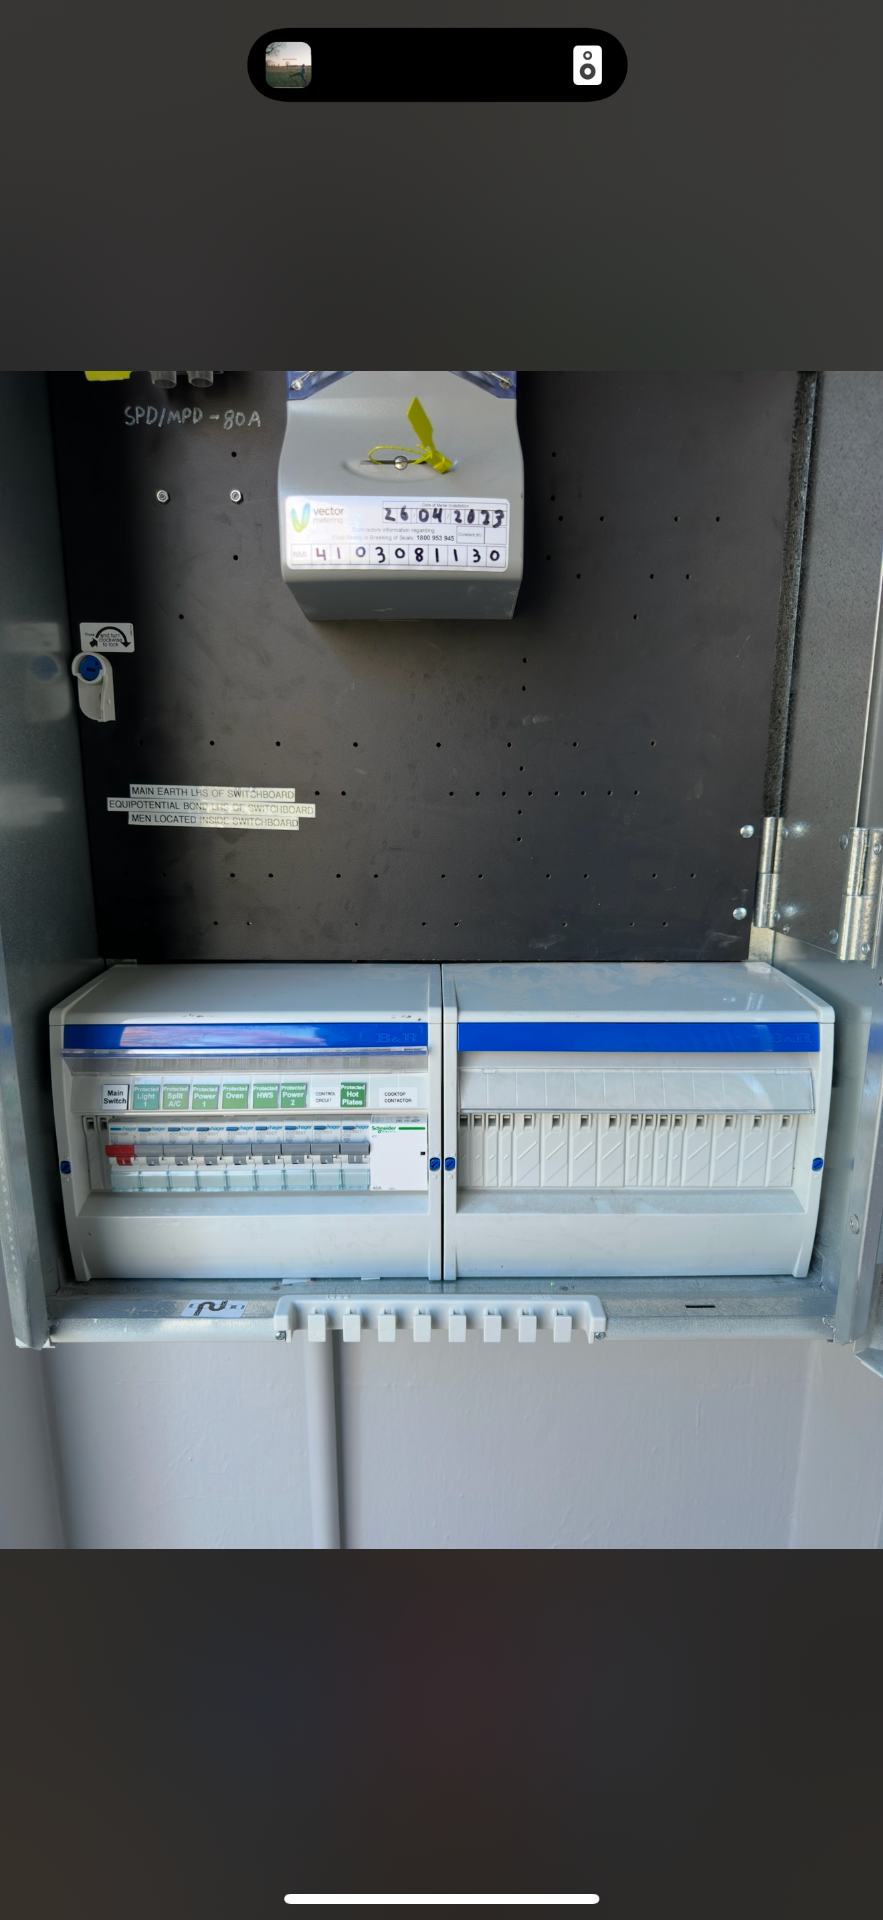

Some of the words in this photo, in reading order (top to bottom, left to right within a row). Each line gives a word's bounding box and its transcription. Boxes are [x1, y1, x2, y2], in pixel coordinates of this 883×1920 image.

[312, 506, 344, 516] vector
[313, 517, 344, 525] metering
[131, 787, 155, 795] MAIN
[157, 787, 188, 796] EARTH
[191, 789, 208, 797] LHS
[211, 789, 225, 798] OF
[227, 789, 294, 800] SWITCHBOARD
[109, 800, 180, 810] EQUIPOTENTIAL
[183, 802, 208, 811] BOND
[248, 804, 313, 815] SWITCHBOARD
[131, 814, 151, 823] MEN
[154, 815, 197, 824] LOCATED
[232, 818, 298, 828] SWITCHBOARD
[103, 1097, 126, 1105] Switch
[137, 1093, 155, 1101] Light
[167, 1093, 183, 1101] Split
